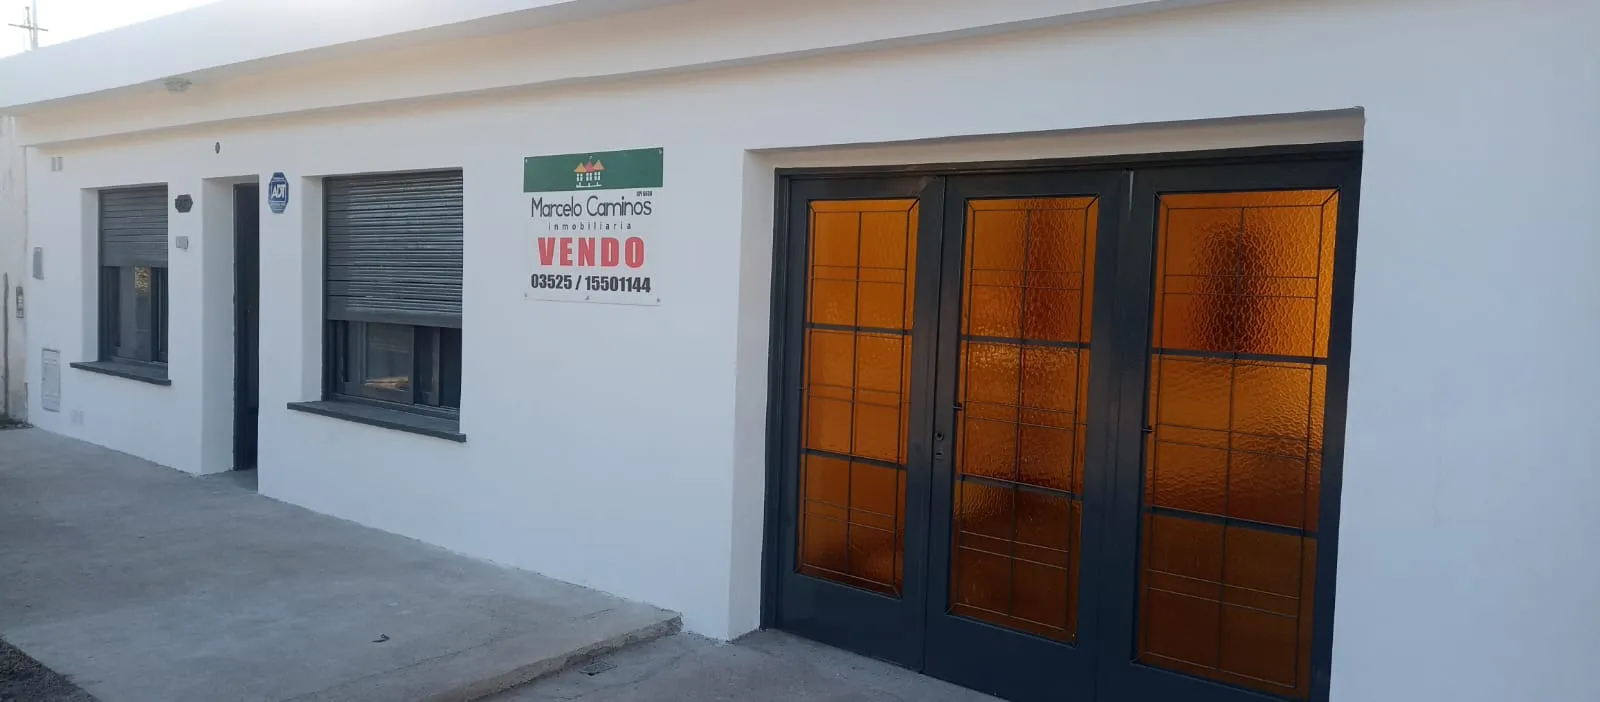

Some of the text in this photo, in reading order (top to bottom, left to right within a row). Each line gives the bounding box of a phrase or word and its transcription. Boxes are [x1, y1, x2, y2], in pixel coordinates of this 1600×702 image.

[271, 184, 285, 199] ADT
[531, 195, 652, 217] Marcelo Caminos
[548, 221, 631, 230] inmobiliaria
[537, 236, 645, 268] VENDO
[531, 274, 651, 293] 03525 / 15501144
